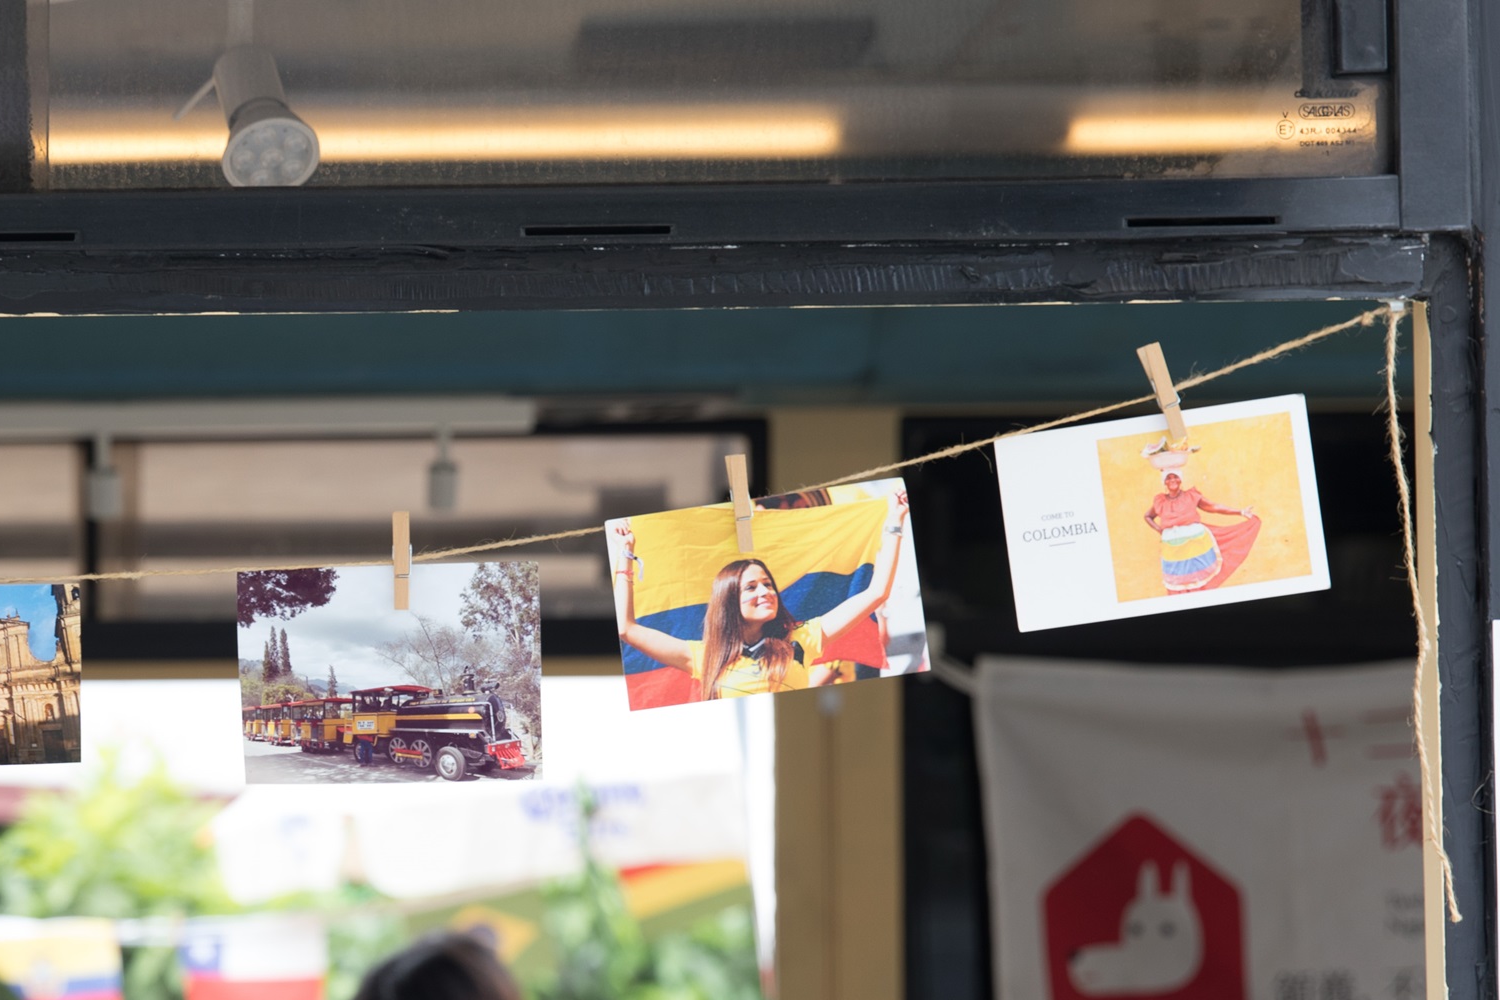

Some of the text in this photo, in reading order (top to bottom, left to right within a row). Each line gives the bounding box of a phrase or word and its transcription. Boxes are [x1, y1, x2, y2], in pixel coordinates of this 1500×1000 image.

[1040, 510, 1075, 521] COME TO
[1022, 521, 1098, 543] COLOMBIA
